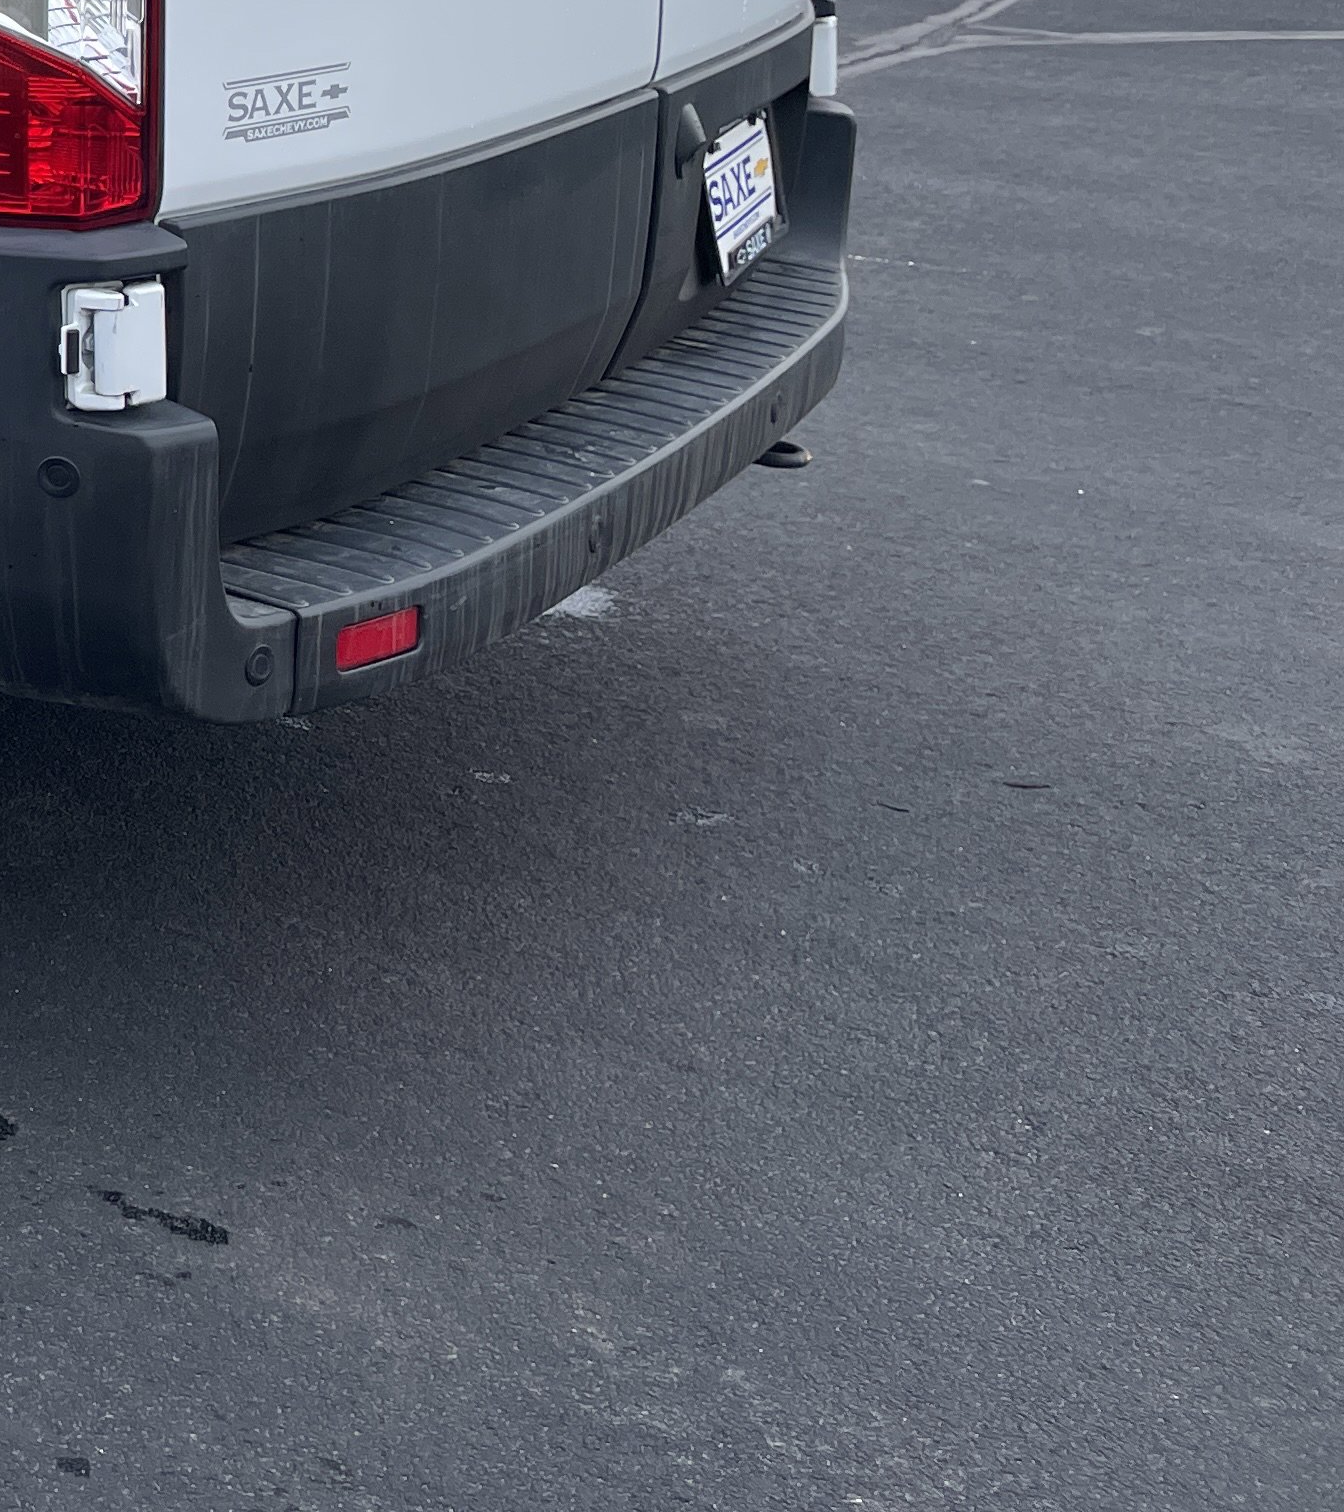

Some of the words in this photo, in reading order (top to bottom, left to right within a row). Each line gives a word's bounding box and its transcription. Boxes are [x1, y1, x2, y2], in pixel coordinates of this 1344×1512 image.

[227, 79, 317, 122] SAXE
[247, 116, 328, 140] SAXECHEVY.COM
[709, 155, 756, 222] SAXE
